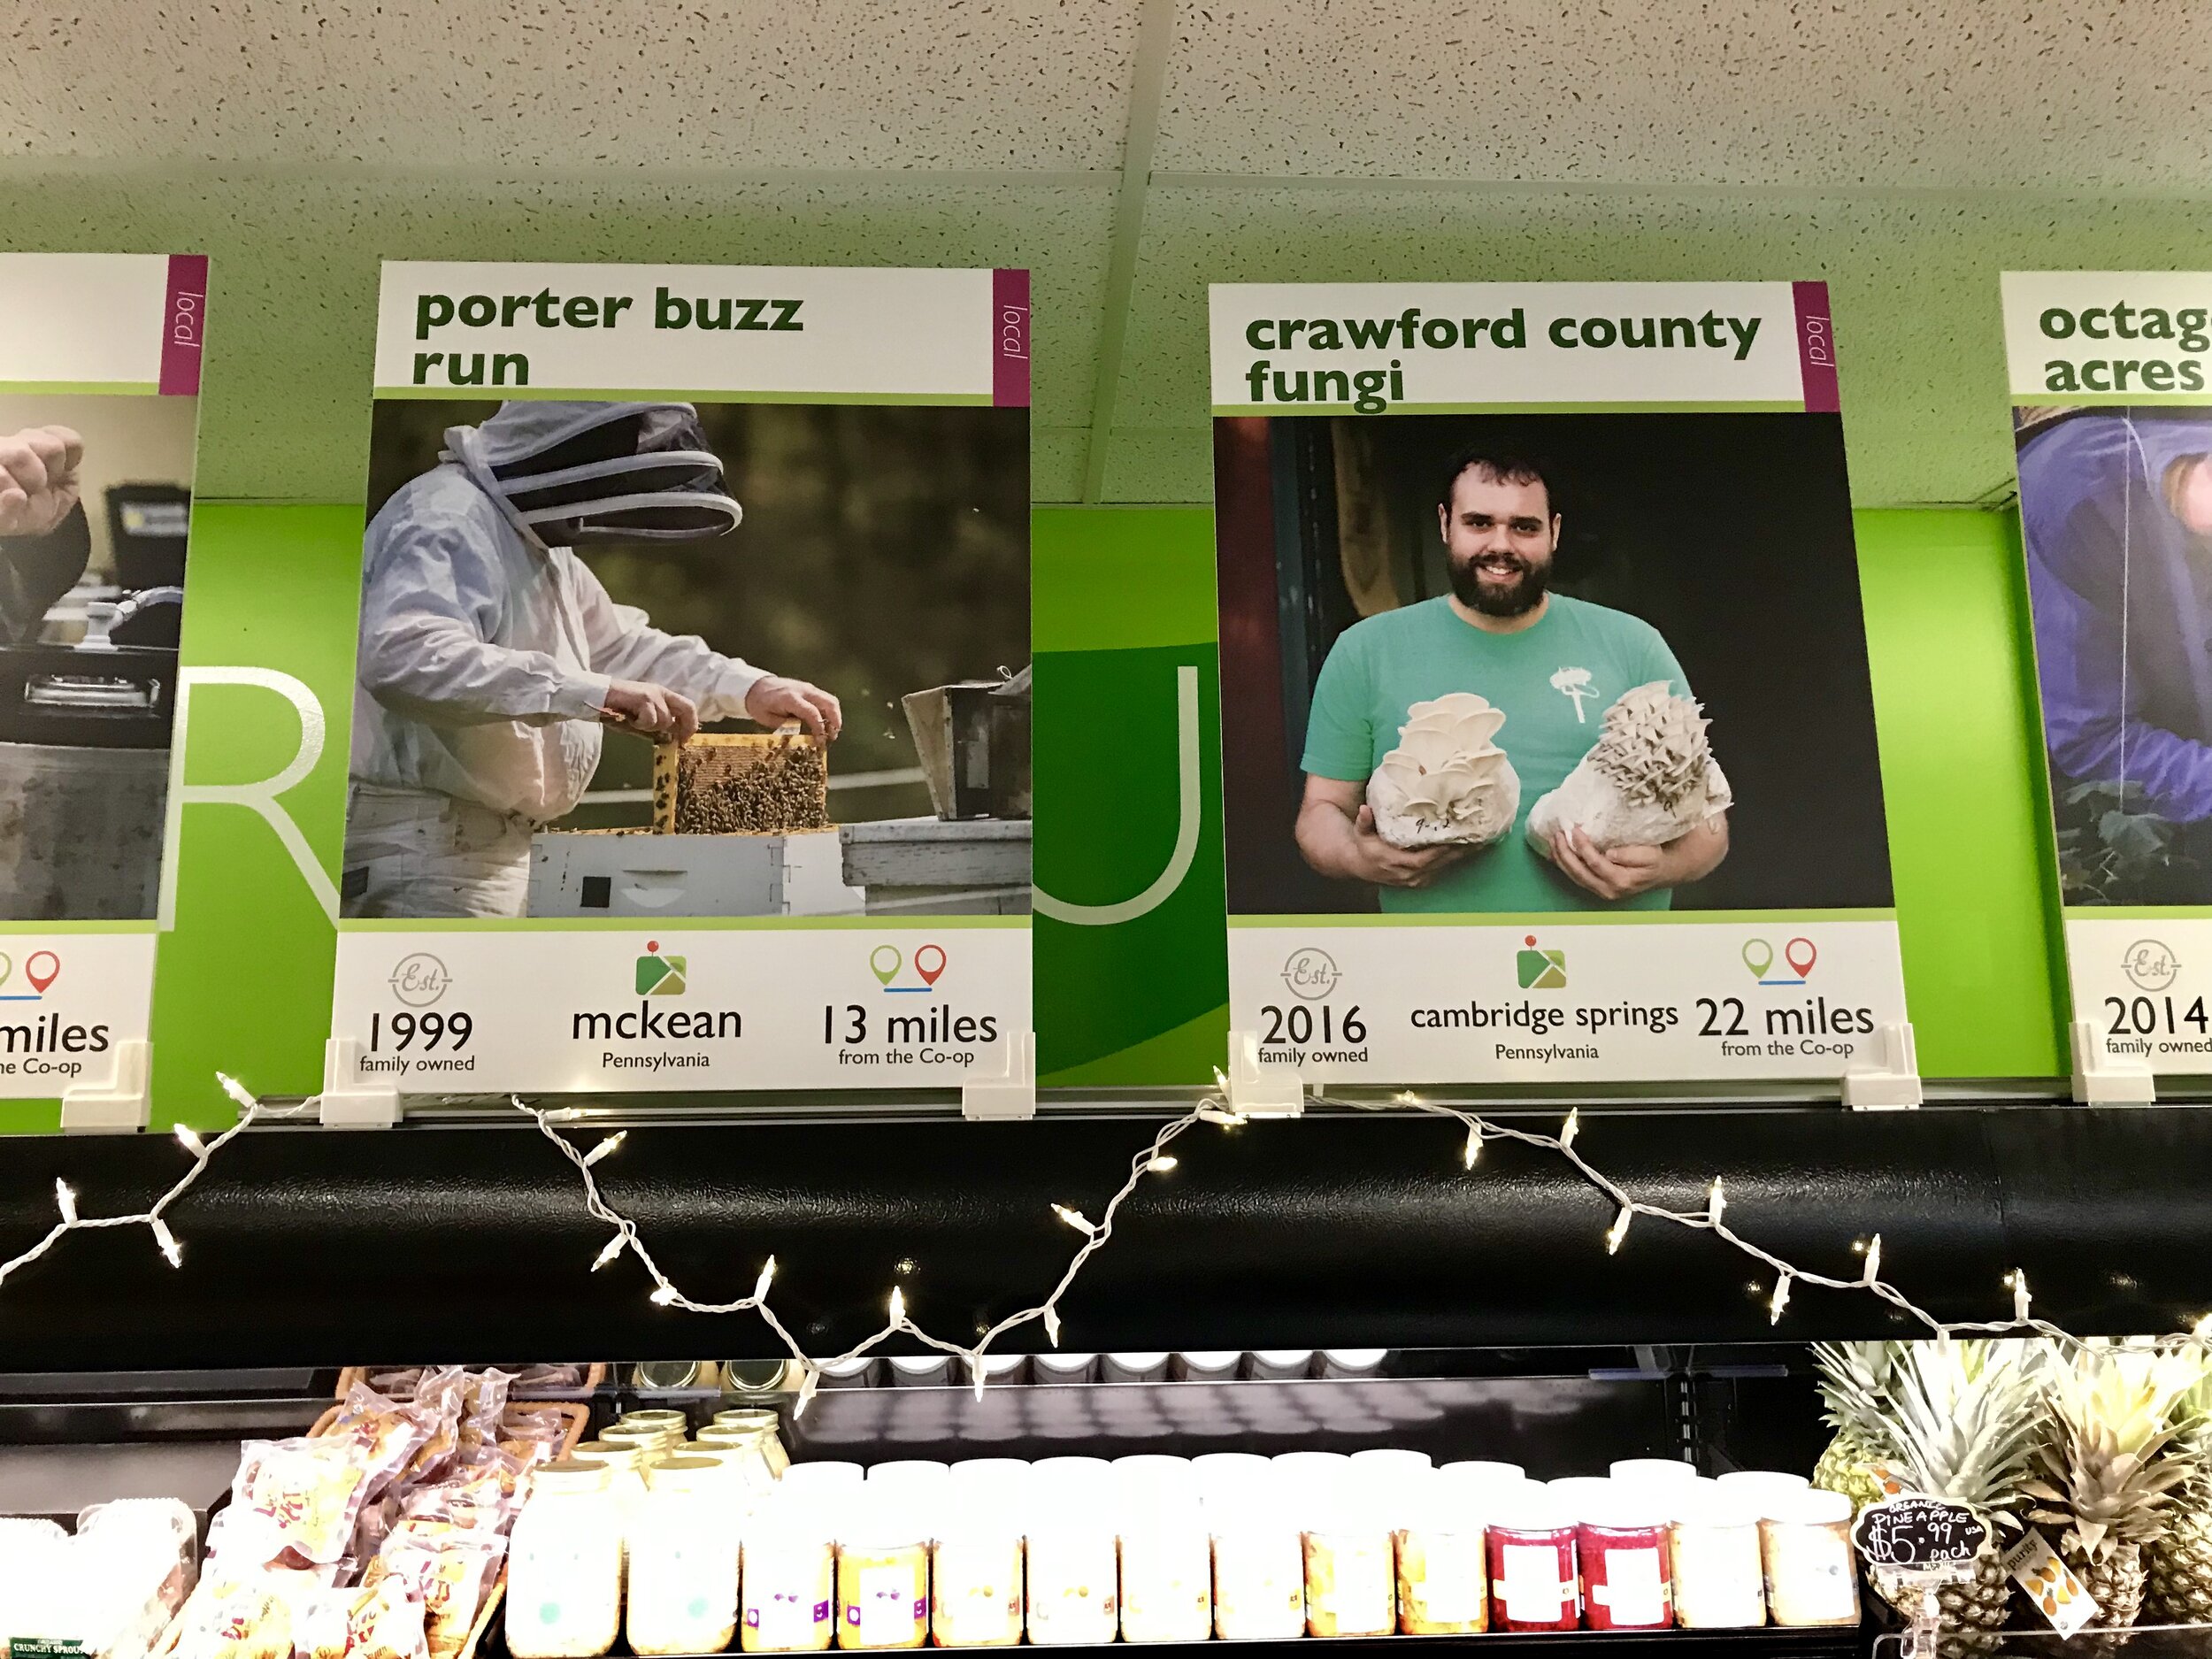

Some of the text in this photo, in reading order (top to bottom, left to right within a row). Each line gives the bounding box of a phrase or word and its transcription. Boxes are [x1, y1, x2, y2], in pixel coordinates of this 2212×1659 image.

[174, 291, 204, 348] local
[416, 287, 803, 340] porter buzz
[1003, 303, 1028, 360] local
[2039, 300, 2212, 352] octag
[1246, 309, 1762, 360] crawford county
[1806, 315, 1834, 366] local
[413, 353, 529, 385] run
[1246, 359, 1403, 414] fungi
[2045, 360, 2204, 391] acres
[0, 1012, 109, 1053] miles
[371, 1011, 473, 1052] 1999
[572, 1000, 742, 1039] mckean
[825, 1004, 997, 1044] 13 miles
[1261, 1004, 1367, 1044] 2016
[1410, 1001, 1678, 1034] cambridge springs
[1695, 996, 1874, 1036] 22 miles
[2105, 995, 2208, 1034] 2014
[360, 1056, 474, 1074] family owned
[603, 1051, 710, 1071] Pennsylvania
[839, 1048, 975, 1067] from the Co-op
[1258, 1047, 1368, 1067] family owned
[1495, 1044, 1600, 1064] Pennsylvania
[1722, 1039, 1854, 1058] from the Co-op
[2106, 1037, 2212, 1057] family owned
[23, 1057, 81, 1078] Co-op
[1872, 1510, 1970, 1526] PINEAPPLE
[1889, 1501, 1946, 1513] ORGANIC
[1866, 1522, 1952, 1564] $5.99
[1930, 1540, 1970, 1563] each
[13, 1643, 51, 1654] CRUNCHY
